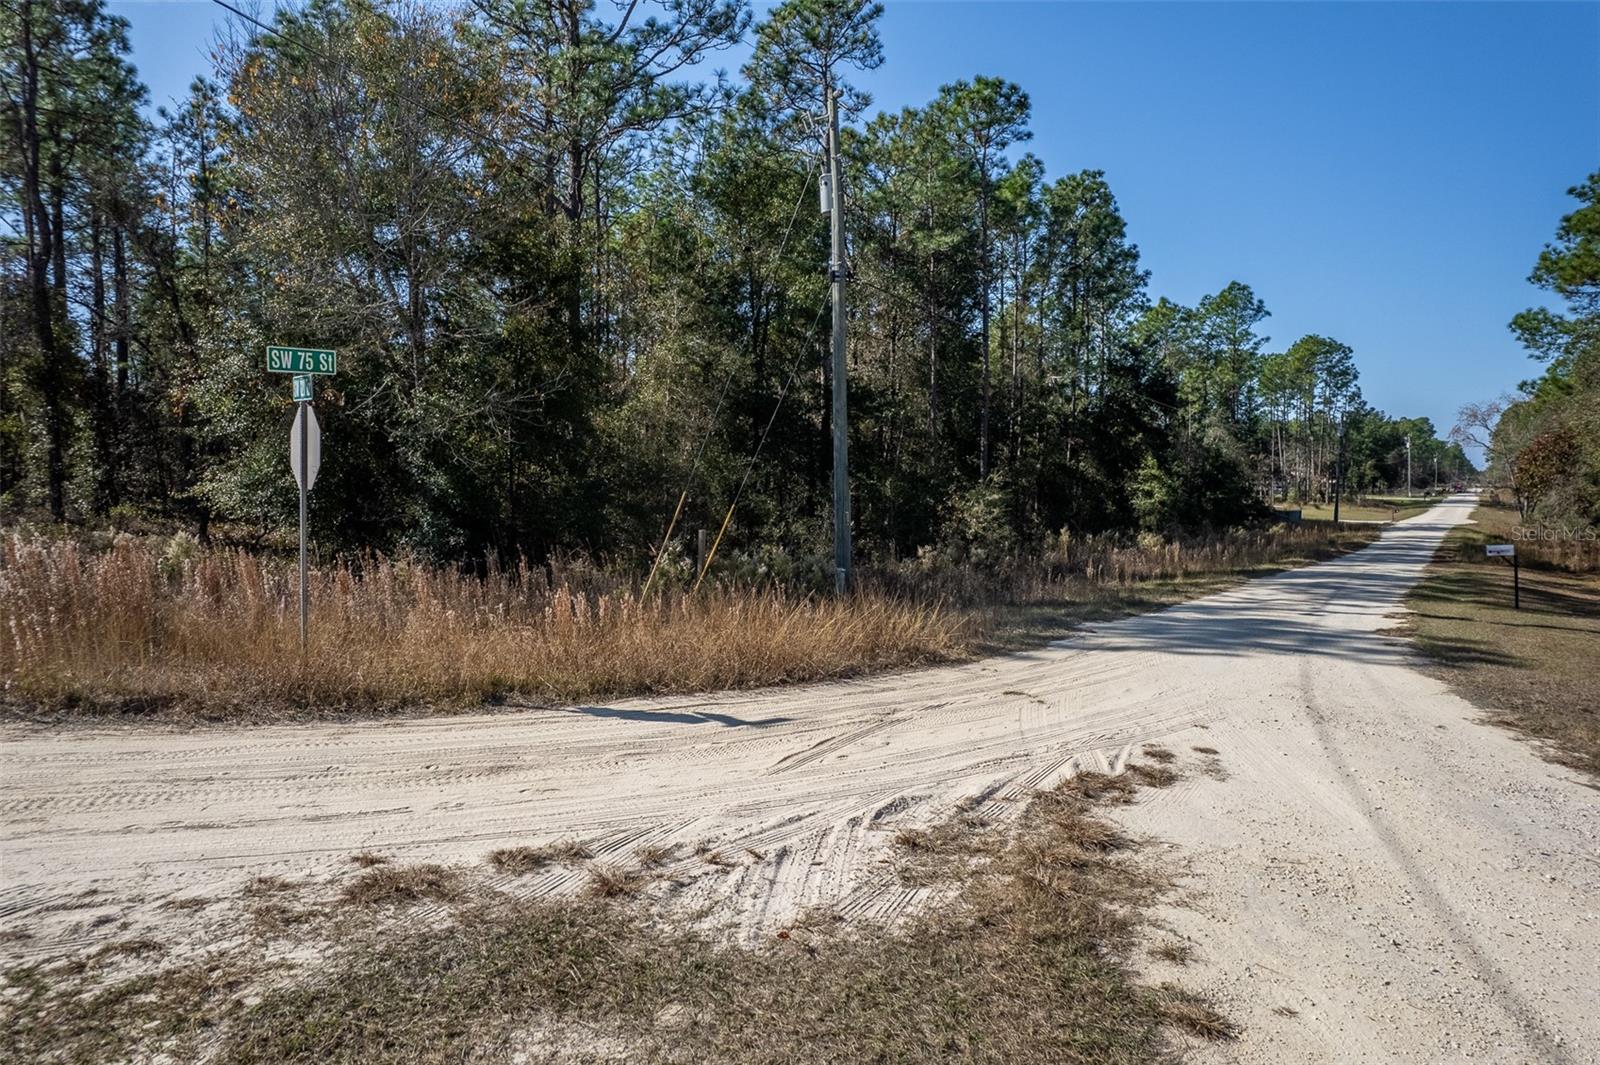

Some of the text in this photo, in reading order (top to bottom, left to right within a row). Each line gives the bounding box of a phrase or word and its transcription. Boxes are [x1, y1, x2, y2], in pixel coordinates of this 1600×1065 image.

[271, 350, 333, 371] SW 75 St
